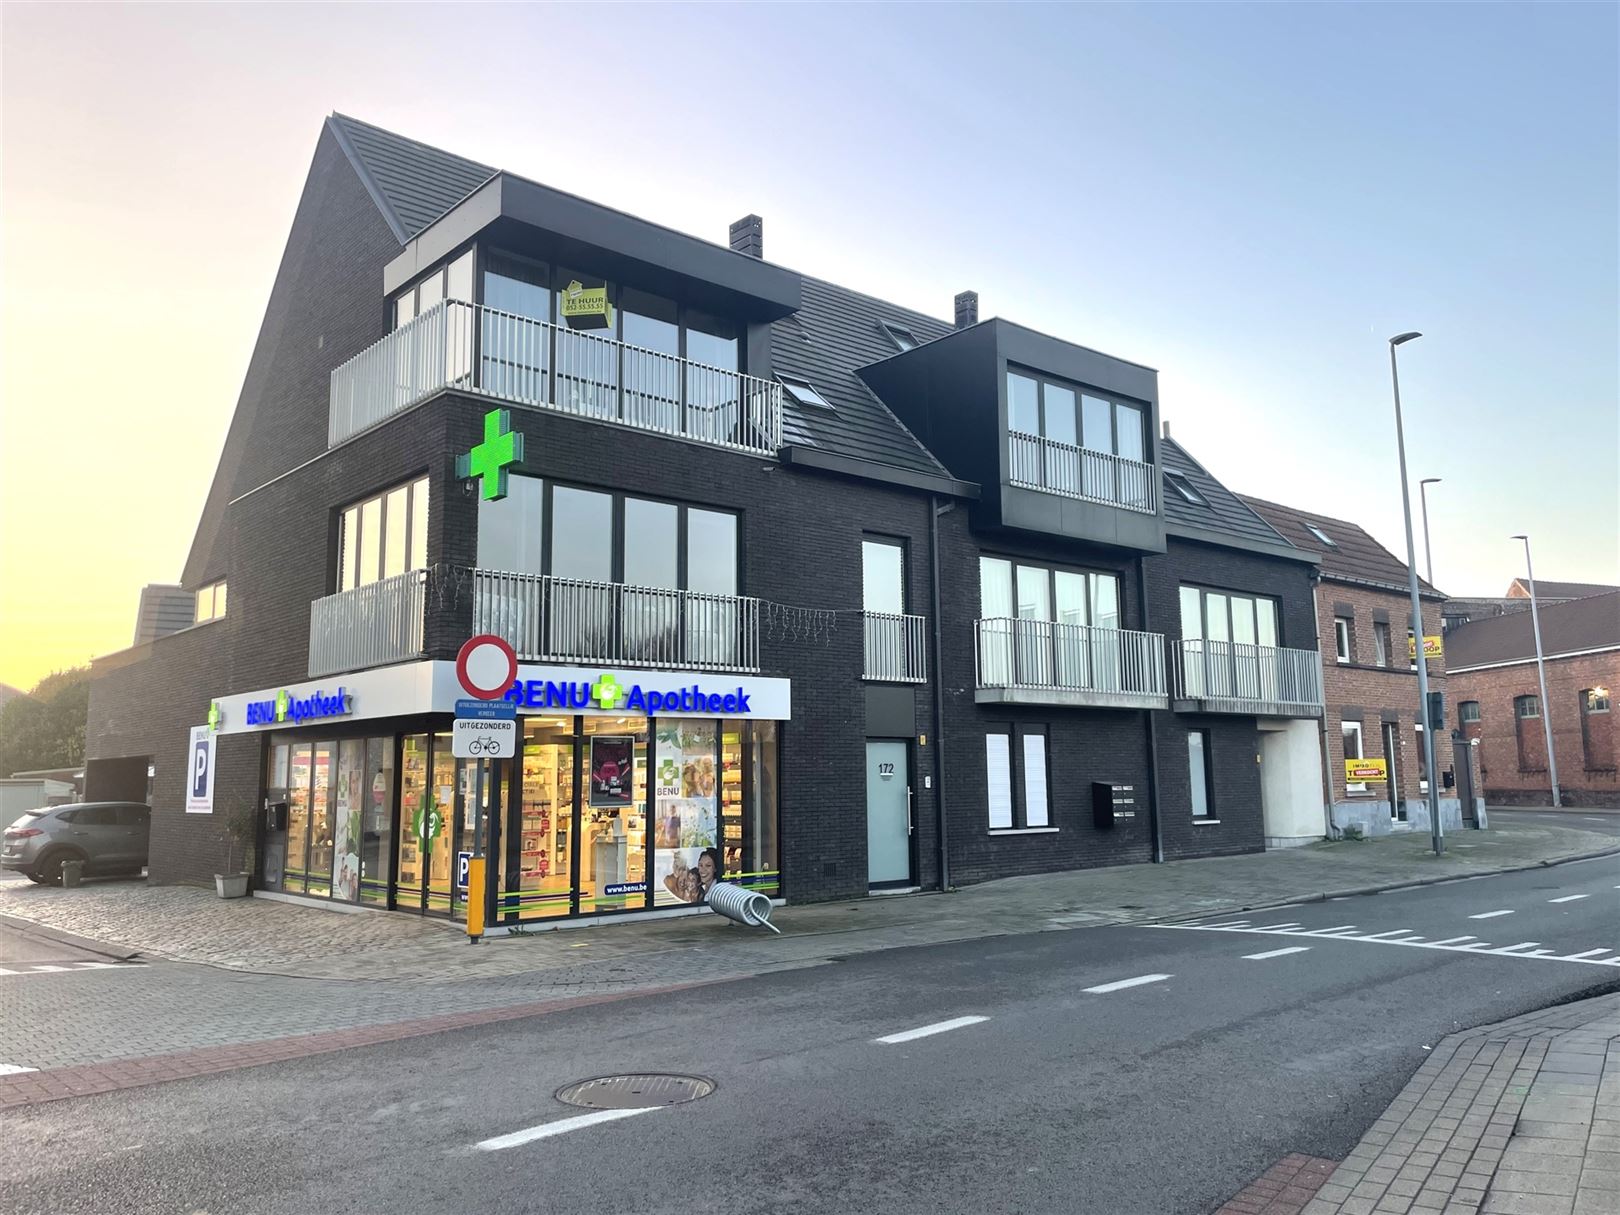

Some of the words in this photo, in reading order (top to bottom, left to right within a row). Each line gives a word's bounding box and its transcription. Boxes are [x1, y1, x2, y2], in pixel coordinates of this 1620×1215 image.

[247, 700, 276, 725] BENU
[287, 687, 349, 725] Apotheek
[504, 680, 590, 709] BENU
[626, 684, 752, 715] Apotheek
[459, 722, 512, 730] UITGEZONDERD
[195, 748, 207, 790] P
[878, 763, 894, 773] 172
[657, 787, 680, 796] BENU
[460, 857, 469, 882] P
[606, 884, 647, 894] www.benu.be
